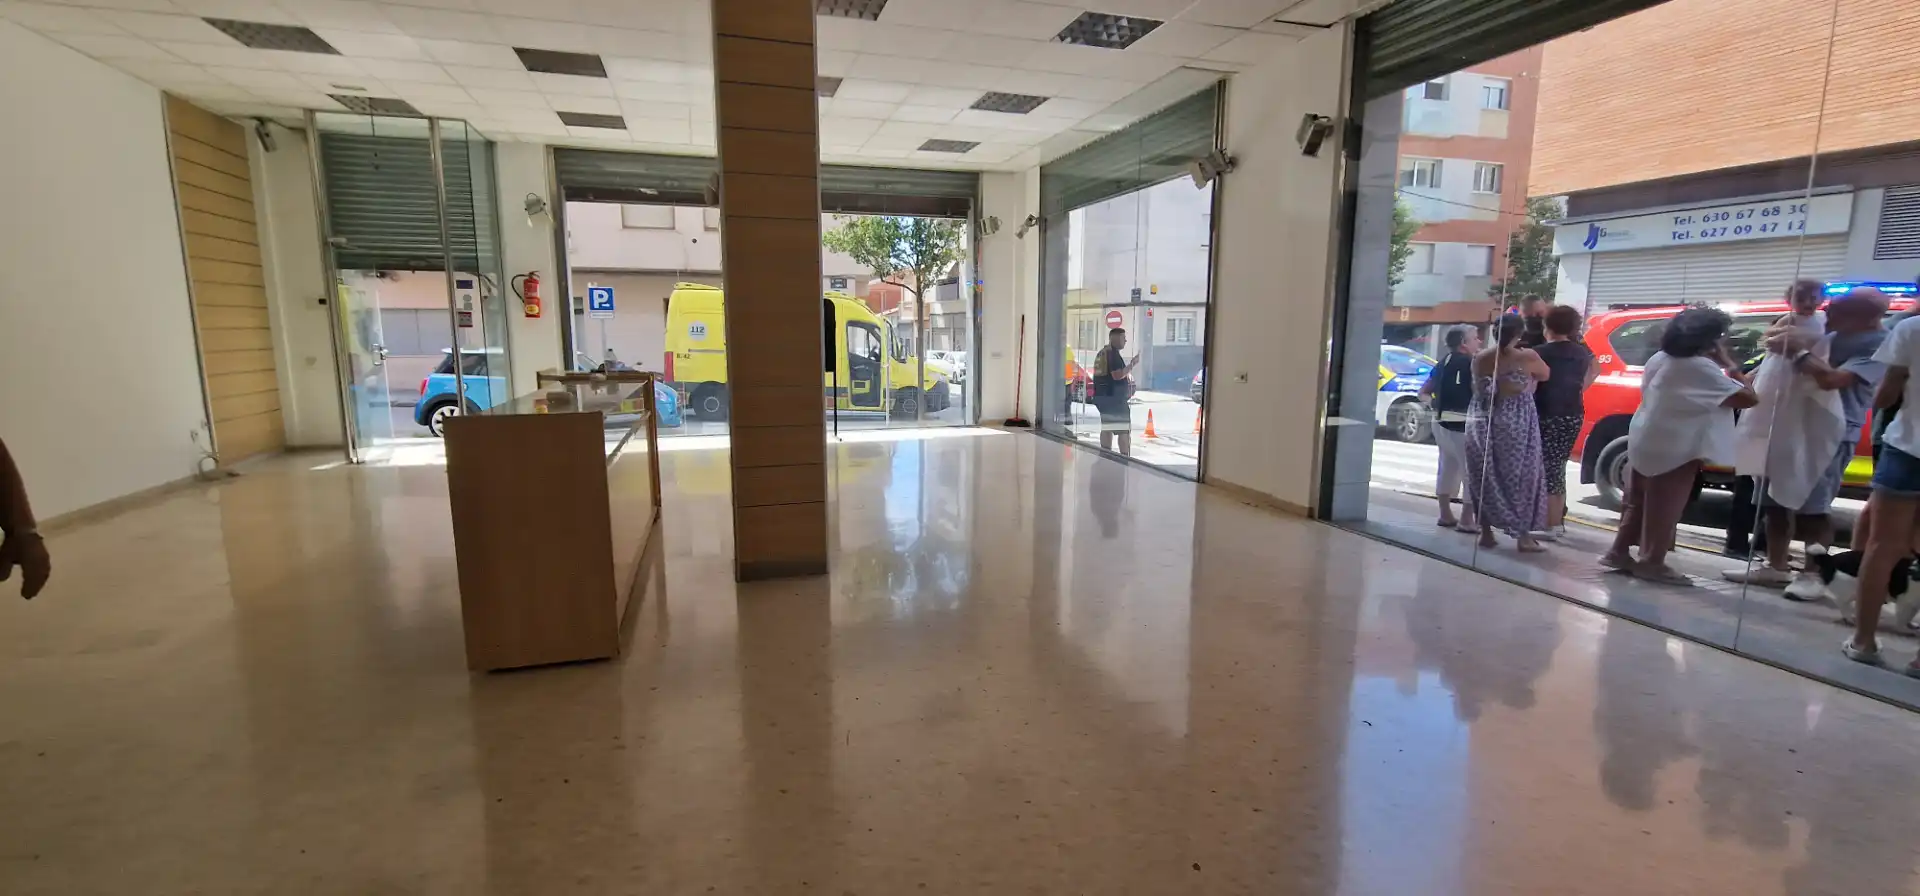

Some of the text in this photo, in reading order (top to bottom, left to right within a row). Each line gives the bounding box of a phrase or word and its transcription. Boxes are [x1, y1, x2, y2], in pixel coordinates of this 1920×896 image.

[1673, 216, 1696, 225] Tel.
[1702, 212, 1730, 223] 630
[1736, 208, 1755, 219] 67
[1761, 206, 1781, 217] 68
[1671, 220, 1805, 240] Tel. 627 09 47 12
[593, 289, 608, 308] P
